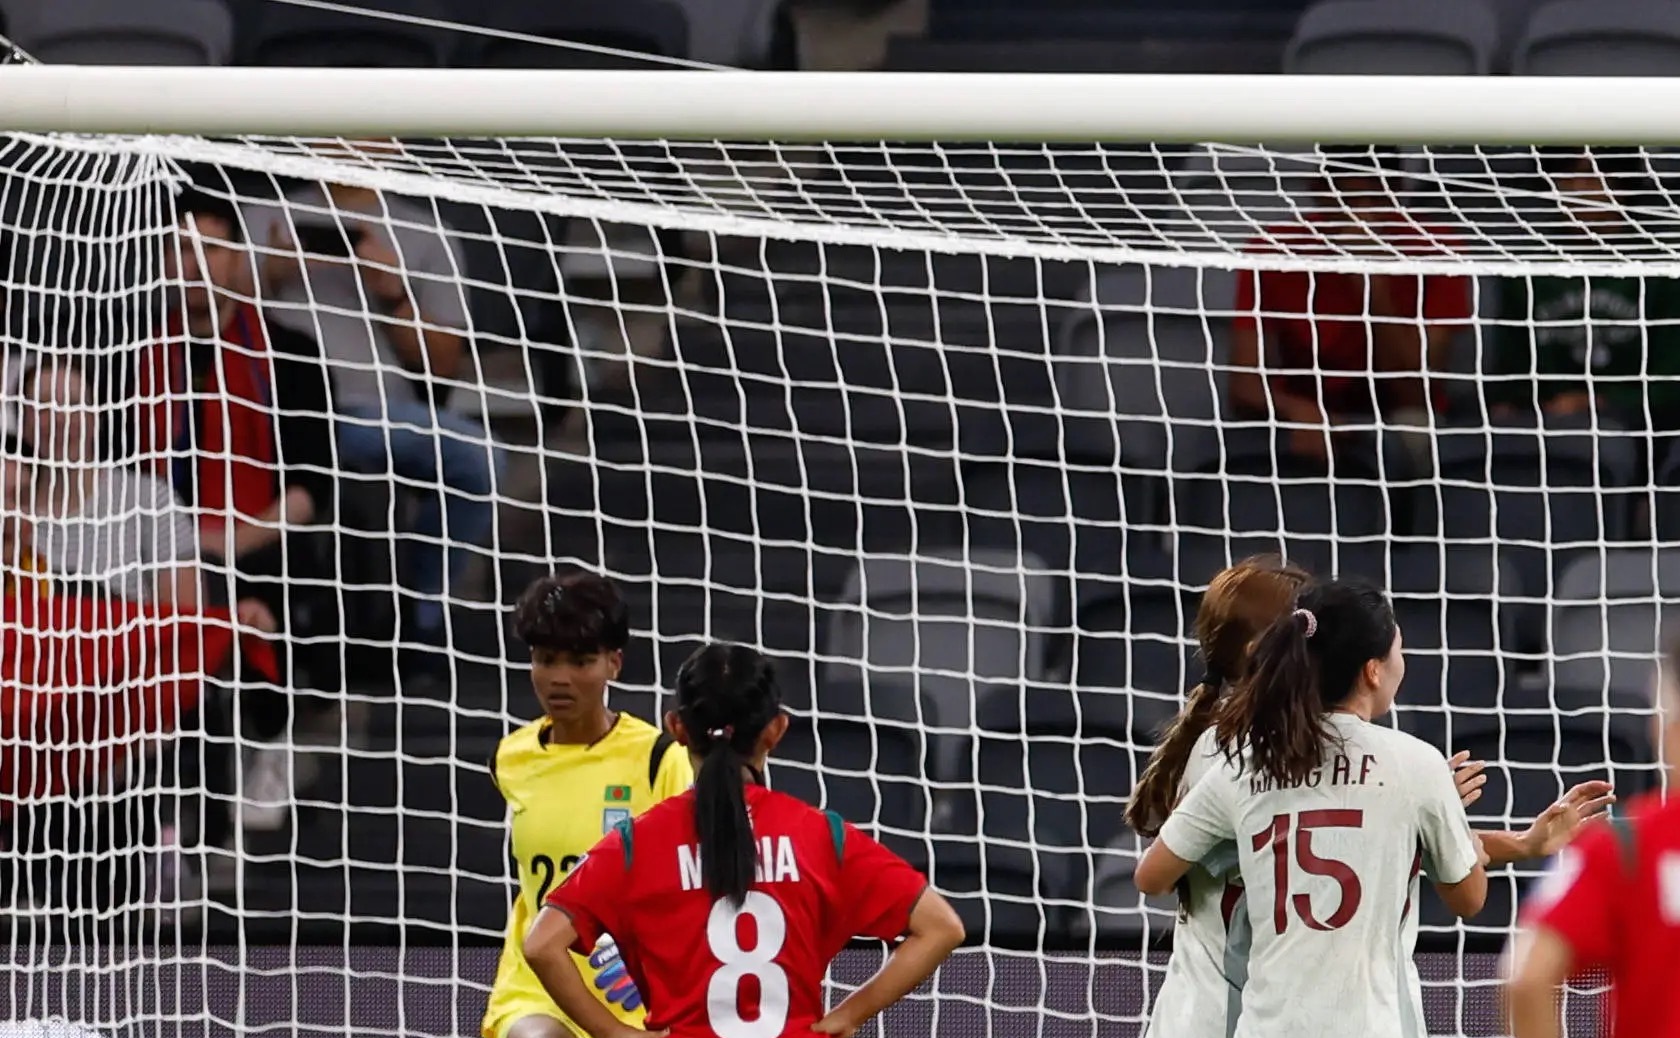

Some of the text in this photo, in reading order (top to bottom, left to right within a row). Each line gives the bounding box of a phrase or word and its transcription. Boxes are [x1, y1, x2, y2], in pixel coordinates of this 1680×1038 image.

[1331, 754, 1384, 787] A.F.
[677, 835, 800, 891] MIA
[1252, 809, 1363, 935] 15
